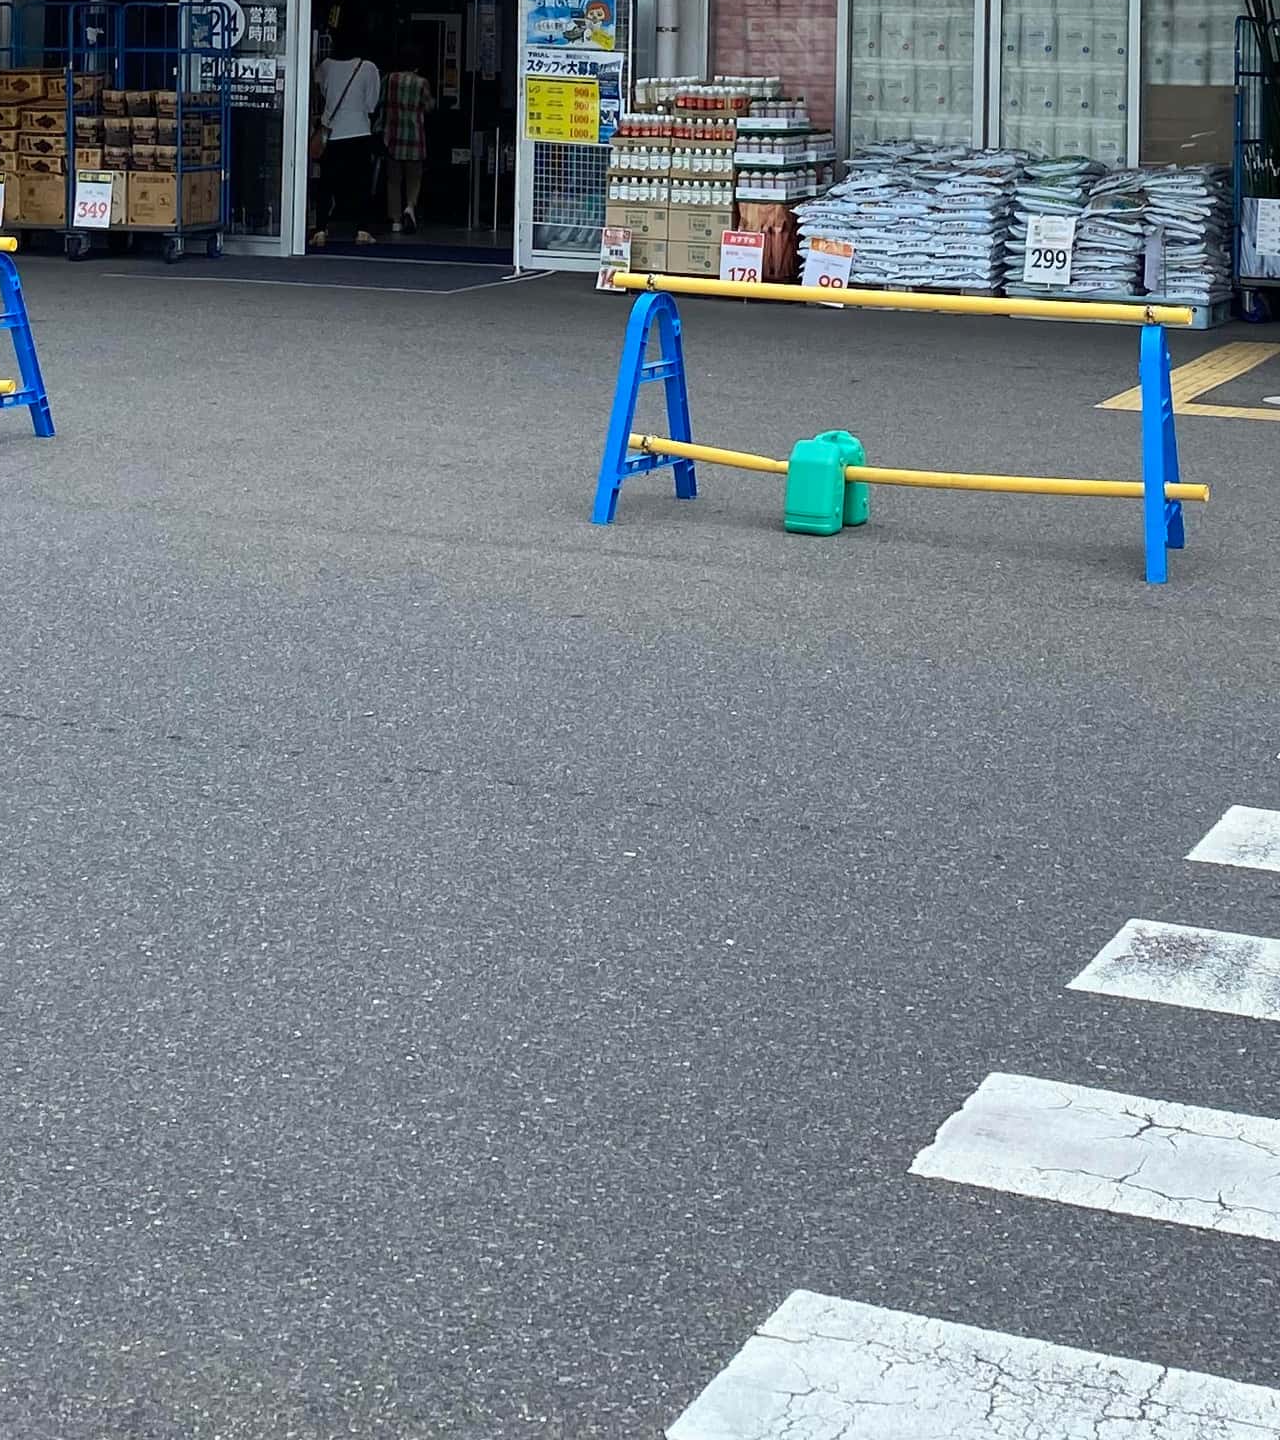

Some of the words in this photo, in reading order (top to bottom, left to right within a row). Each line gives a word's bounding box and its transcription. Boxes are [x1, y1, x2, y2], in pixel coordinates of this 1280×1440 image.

[249, 7, 278, 24] 営業
[248, 26, 278, 42] 時間
[78, 201, 108, 218] 349
[1031, 248, 1067, 270] 299
